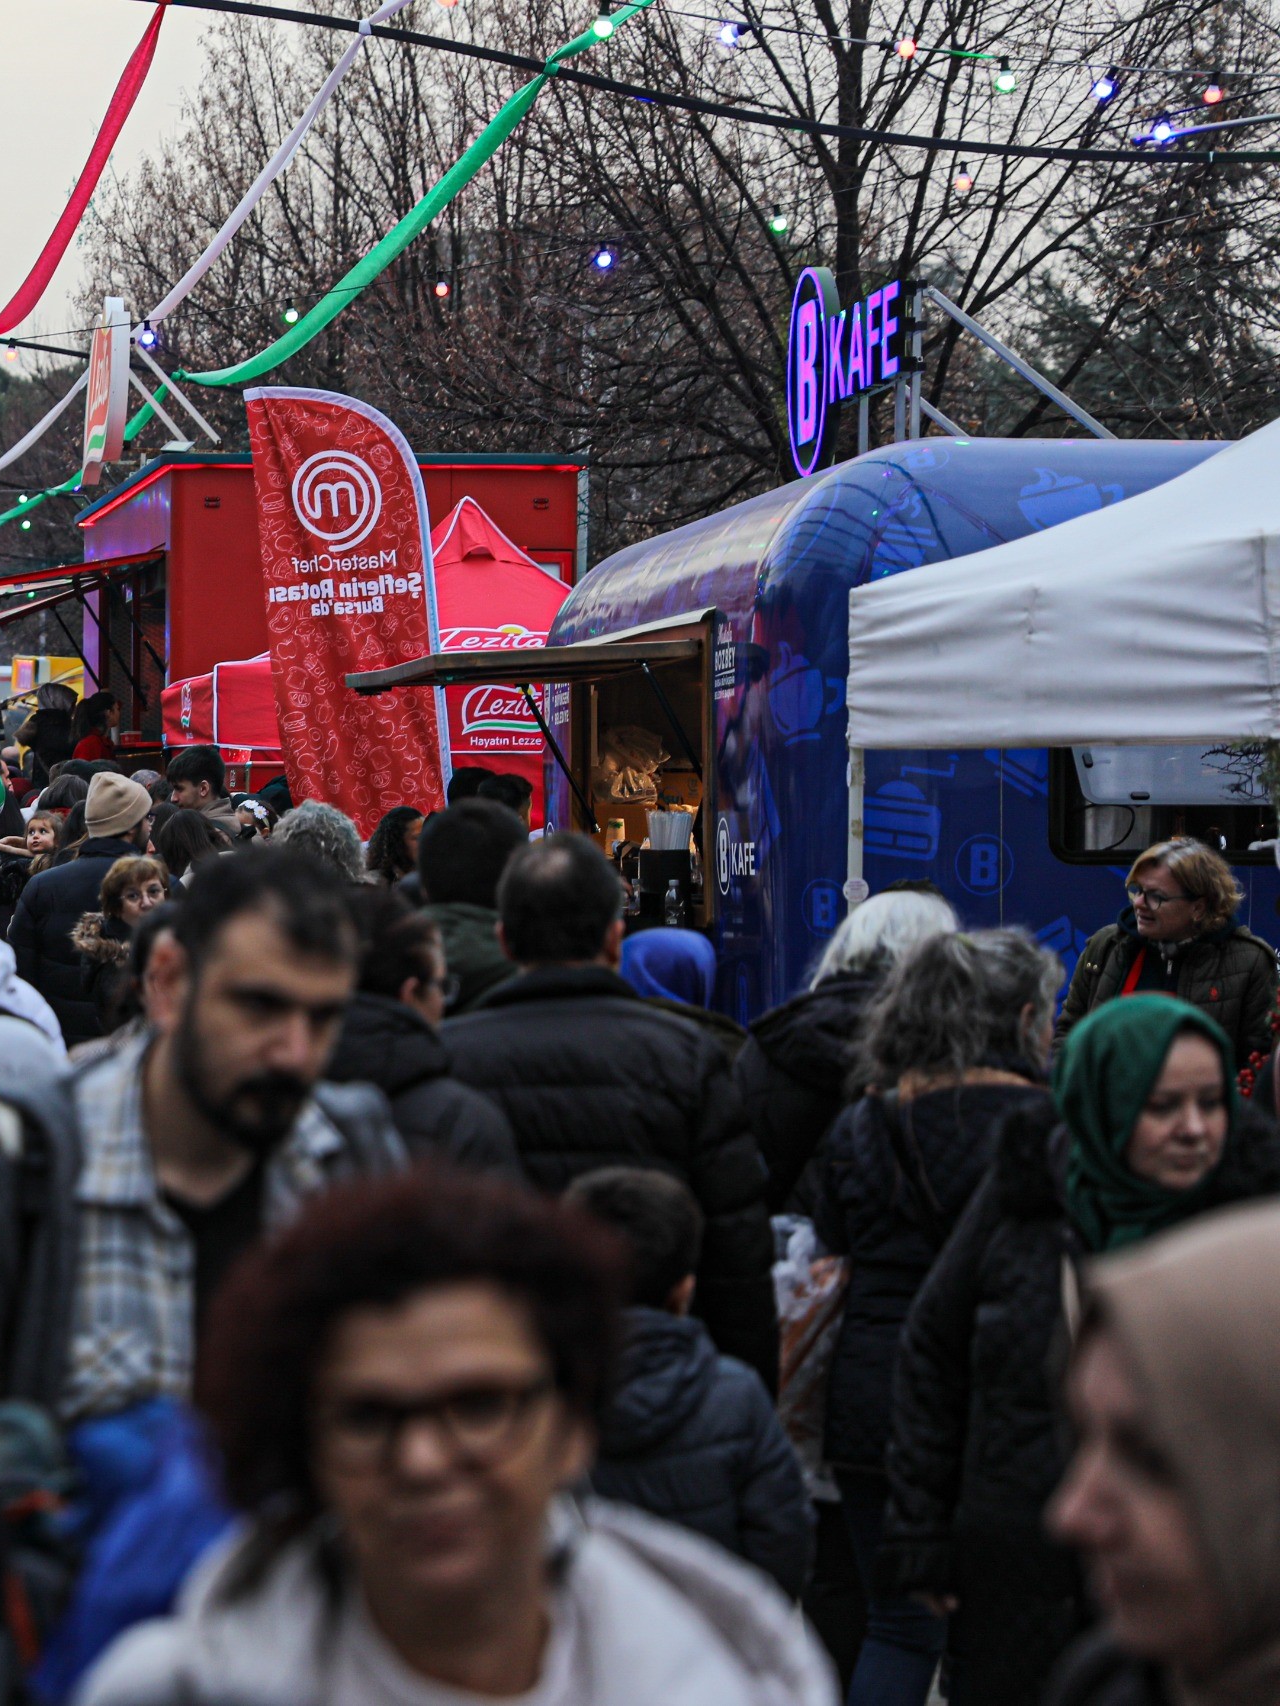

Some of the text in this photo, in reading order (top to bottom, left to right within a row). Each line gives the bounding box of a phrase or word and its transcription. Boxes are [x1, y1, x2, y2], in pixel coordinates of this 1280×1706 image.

[797, 280, 900, 447] B KAFE
[440, 629, 546, 650] Lezita
[470, 736, 510, 748] Hayatın
[720, 829, 756, 883] B KAFE
[970, 843, 998, 886] B
[813, 887, 837, 928] B
